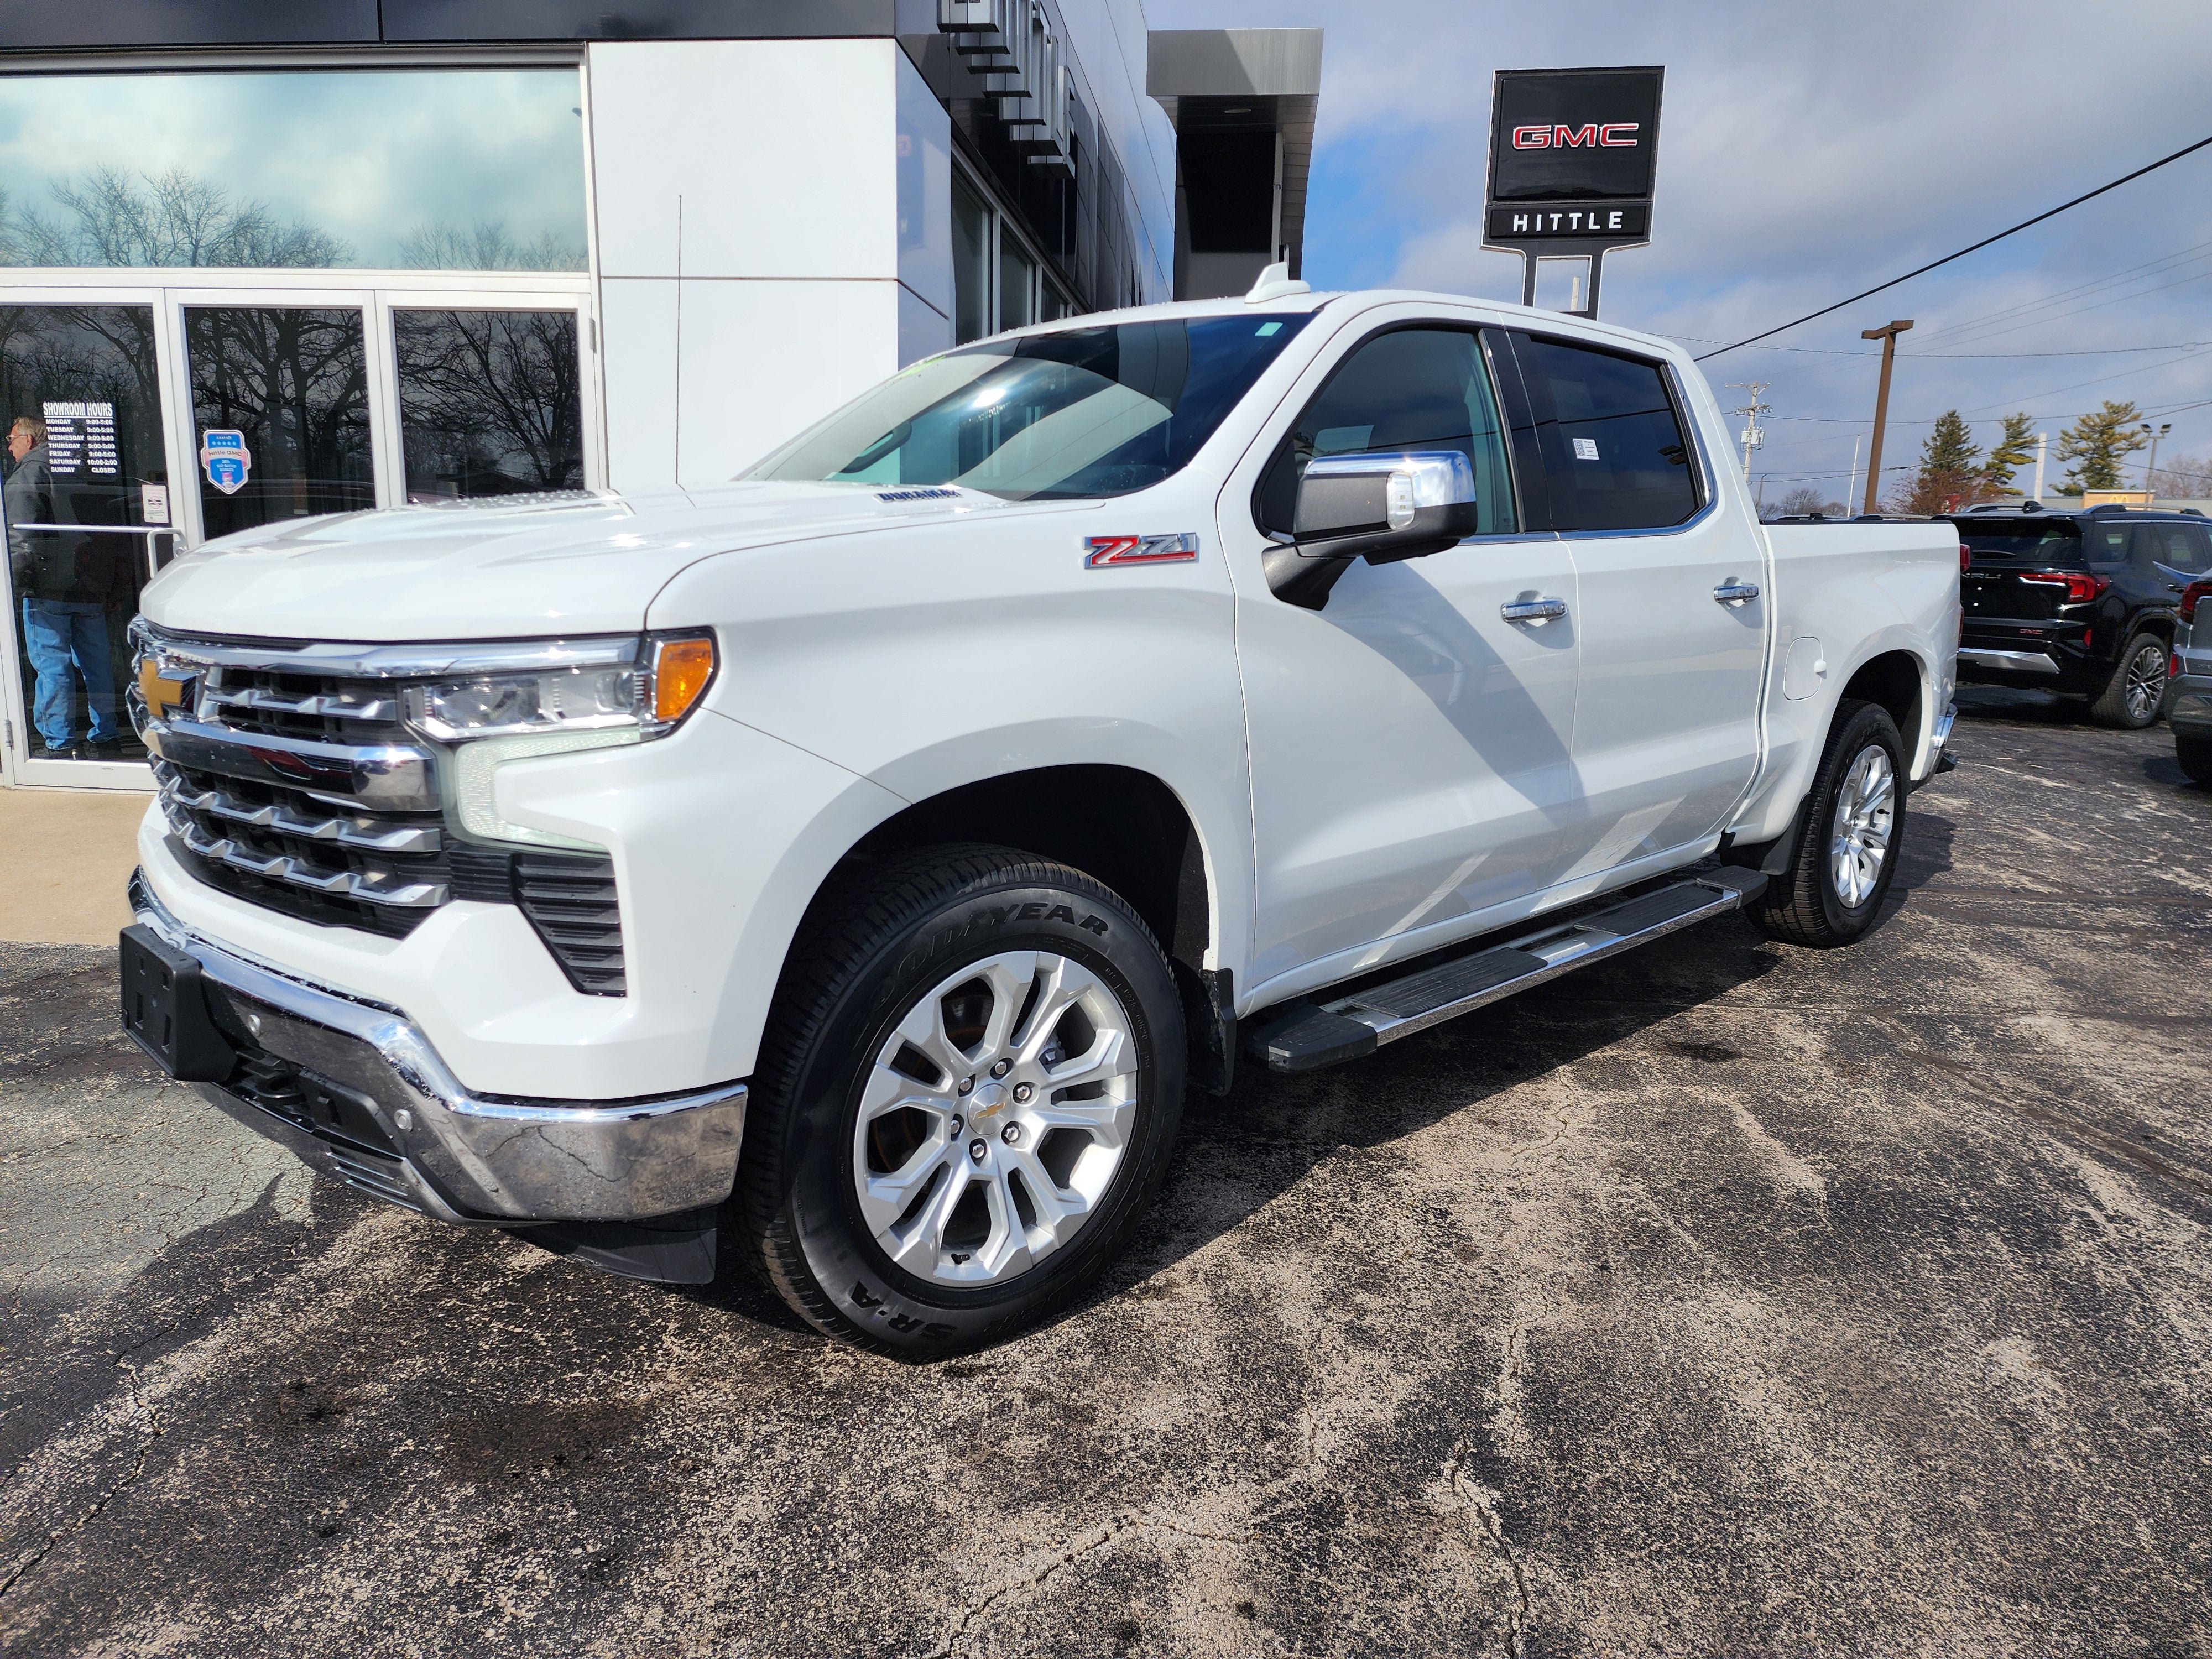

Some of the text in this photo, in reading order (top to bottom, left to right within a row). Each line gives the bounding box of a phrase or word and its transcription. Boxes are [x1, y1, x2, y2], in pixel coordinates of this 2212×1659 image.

[1512, 123, 1640, 149] GMC
[1512, 212, 1624, 232] HITTLE
[43, 402, 113, 416] SHOWROOM HOURS
[1084, 532, 1198, 569] Z71
